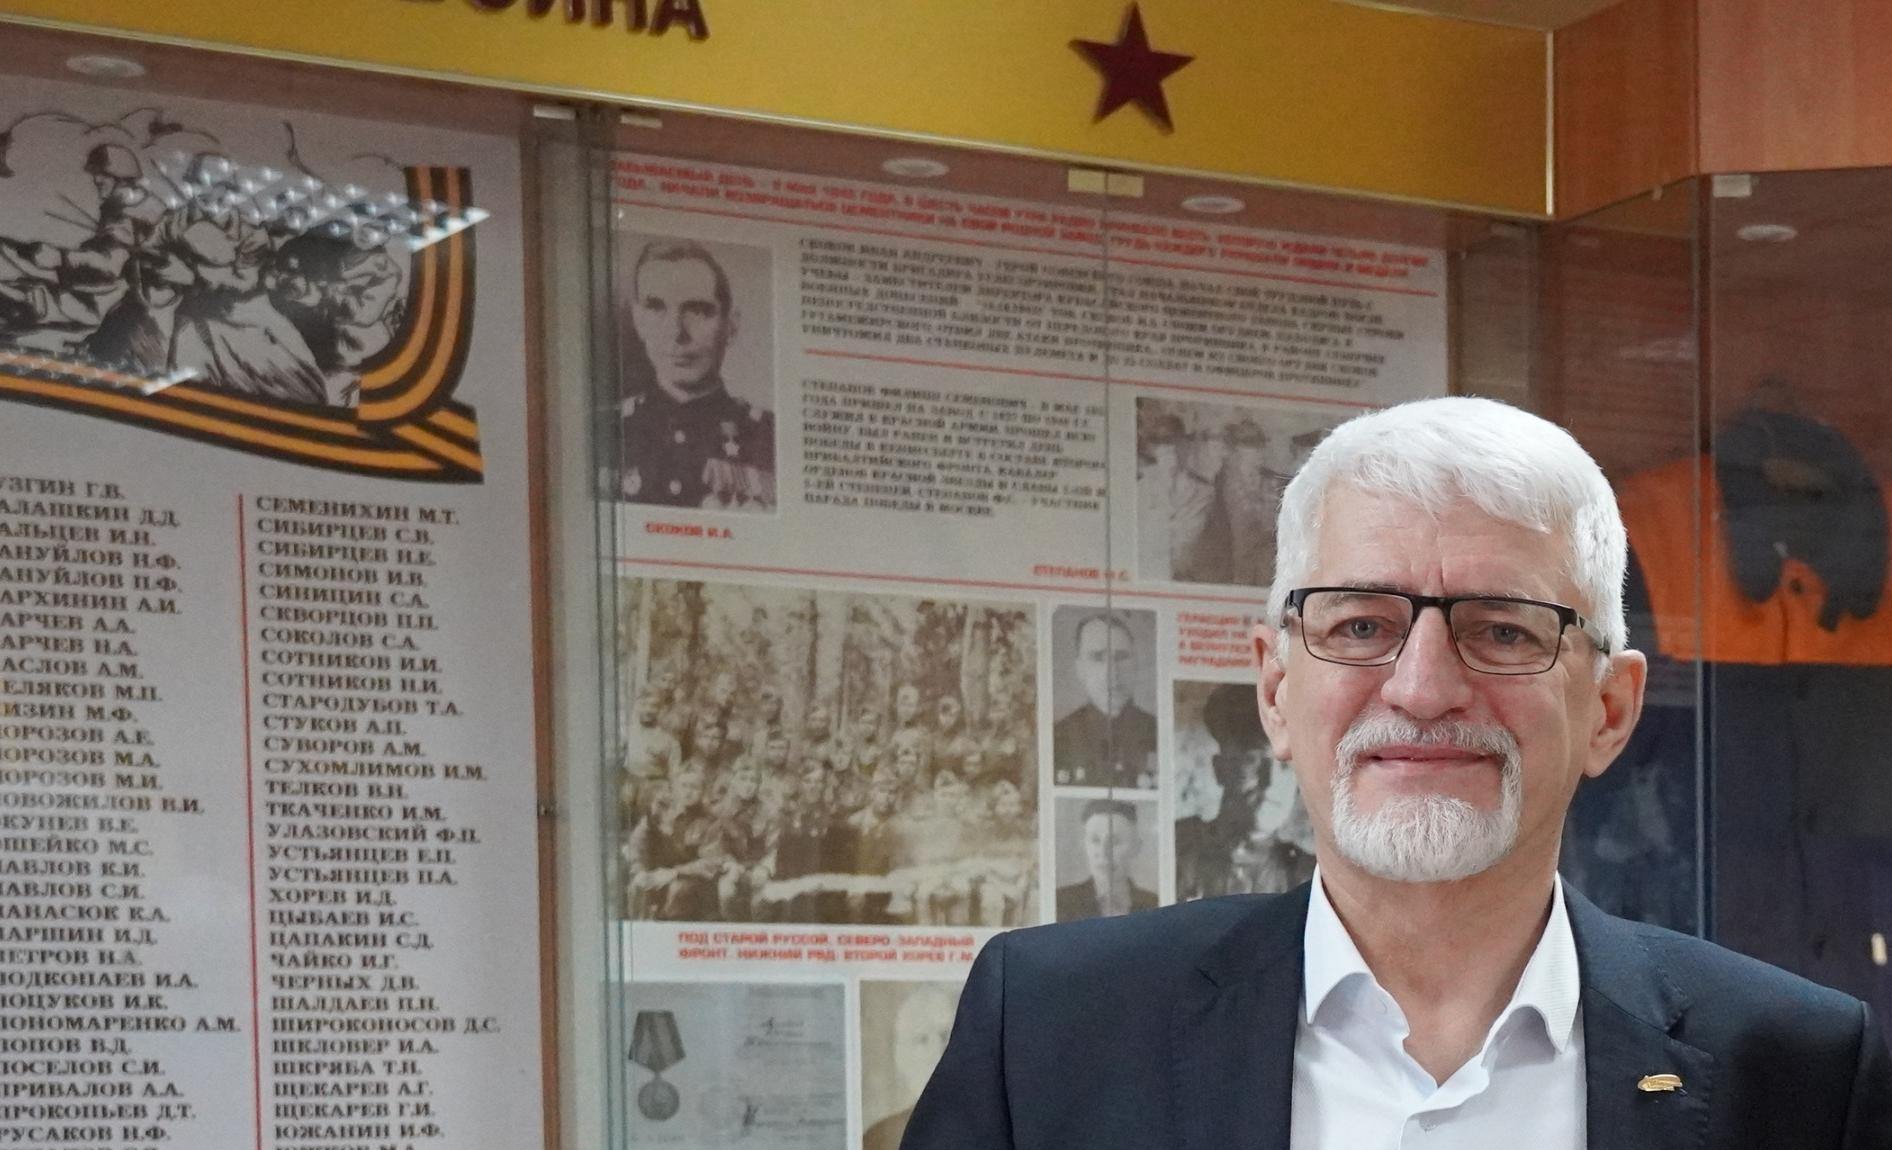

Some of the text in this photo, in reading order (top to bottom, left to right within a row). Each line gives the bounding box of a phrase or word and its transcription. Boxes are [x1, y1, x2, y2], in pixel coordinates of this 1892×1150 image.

[256, 518, 388, 541] СИБИРЦЕВ
[256, 540, 390, 562] СИБИРЦЕВ
[257, 562, 380, 583] СИМОНОВ
[259, 606, 389, 627] СКВОРЦОВ
[259, 628, 375, 647] СОКОЛОВ
[260, 649, 392, 670] СОТНИКОВ
[261, 671, 392, 691] СОТНИКОВ
[261, 693, 419, 713] СТАРОДУБОВ
[262, 715, 358, 732] СТУКОВ
[263, 736, 376, 754] СУВОРОВ
[264, 801, 394, 819] ТКАЧЕНКО
[266, 845, 410, 862] УСТЬЯНЦЕВ
[267, 866, 411, 884] УСТЬЯНЦЕВ
[267, 887, 348, 904] ХОРЕВ
[267, 910, 371, 926] ЦЫБАЕВ
[269, 951, 354, 968] ЧАЙКО
[270, 974, 372, 990] ЧЕРНЫХ
[271, 1017, 457, 1032] ШИРОКОНОСОВ
[272, 1081, 390, 1097] ЩЕКАРЕВ
[273, 1102, 392, 1118] ЩЕКАРЕВ
[274, 1124, 391, 1139] ЮЖАНИН
